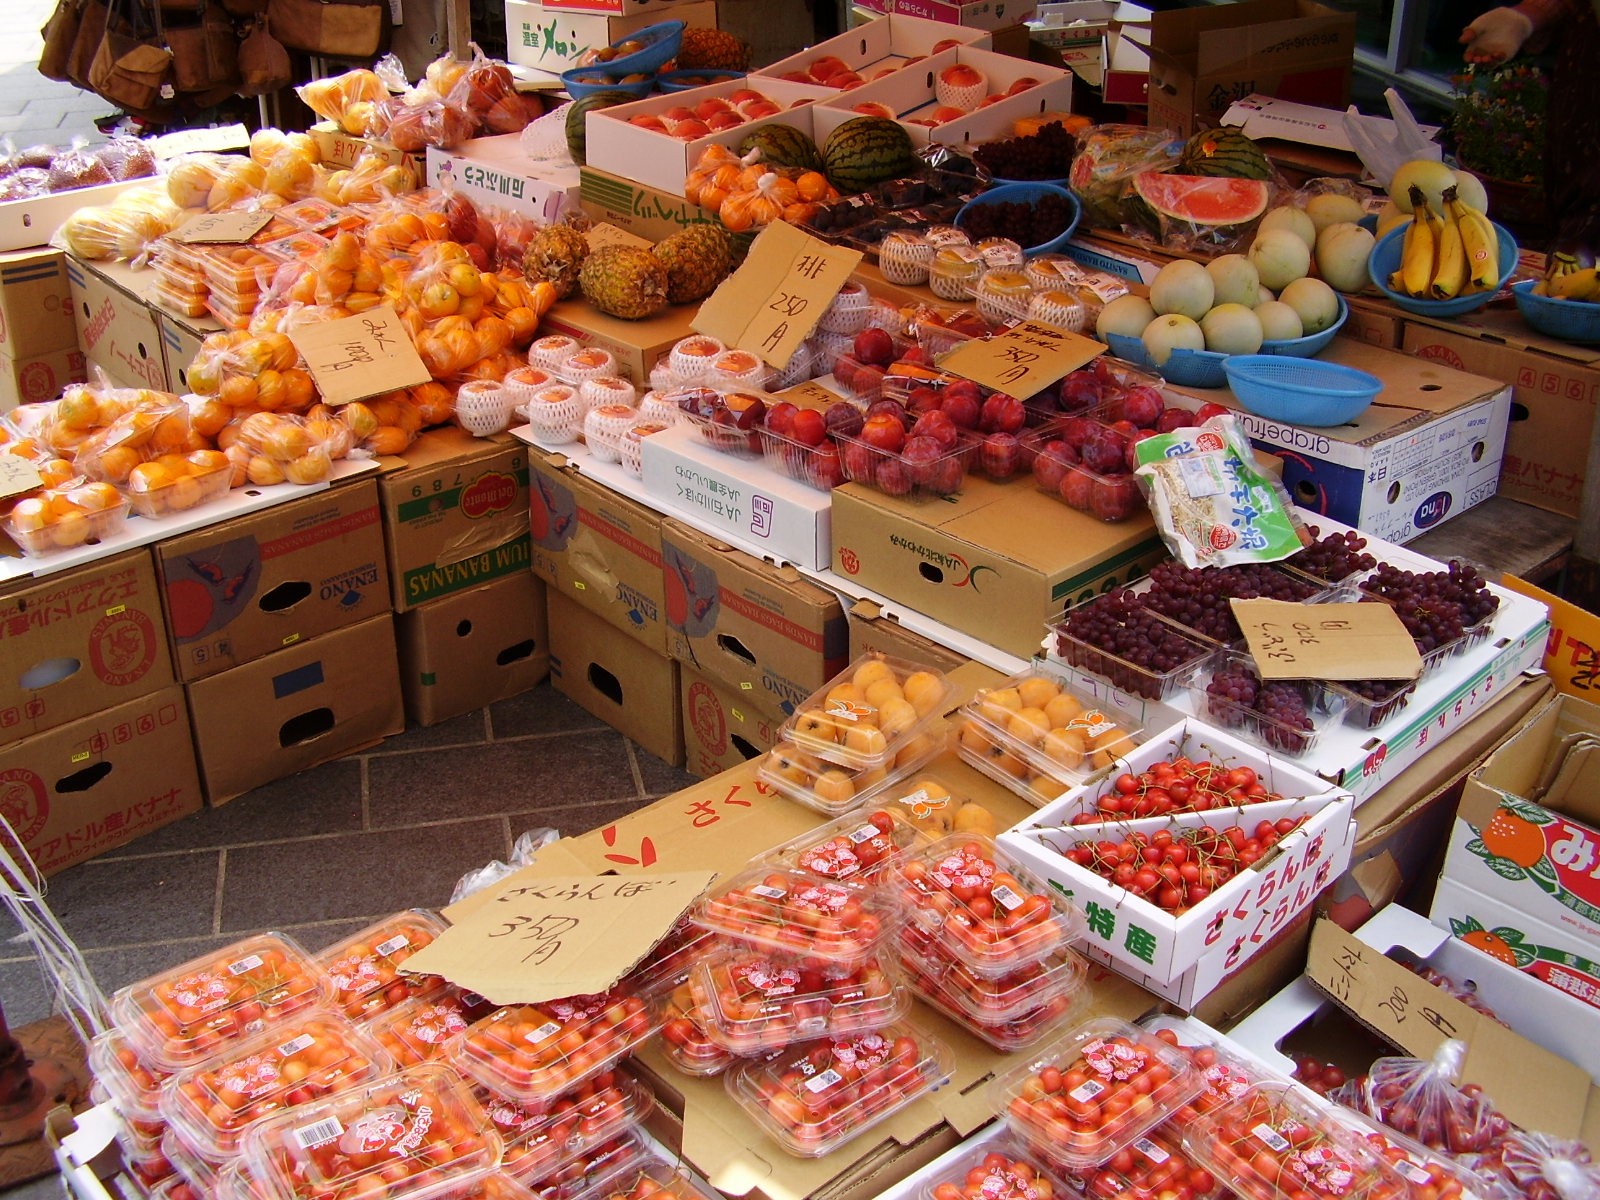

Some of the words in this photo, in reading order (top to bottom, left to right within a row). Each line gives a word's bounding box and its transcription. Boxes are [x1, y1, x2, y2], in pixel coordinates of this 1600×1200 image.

[462, 167, 525, 201] 石川ぶどう
[769, 292, 808, 320] 250
[464, 488, 497, 509] Monte
[319, 568, 379, 601] ENANO
[409, 555, 491, 596] BANANAS
[1253, 621, 1296, 664] ぶどう
[497, 879, 678, 903] さくらんぼ
[1203, 826, 1327, 947] さくらんぼ
[488, 913, 580, 941] 350
[1047, 877, 1157, 966] 特産
[1223, 853, 1334, 970] さくらんぼ
[1379, 985, 1409, 1024] 200
